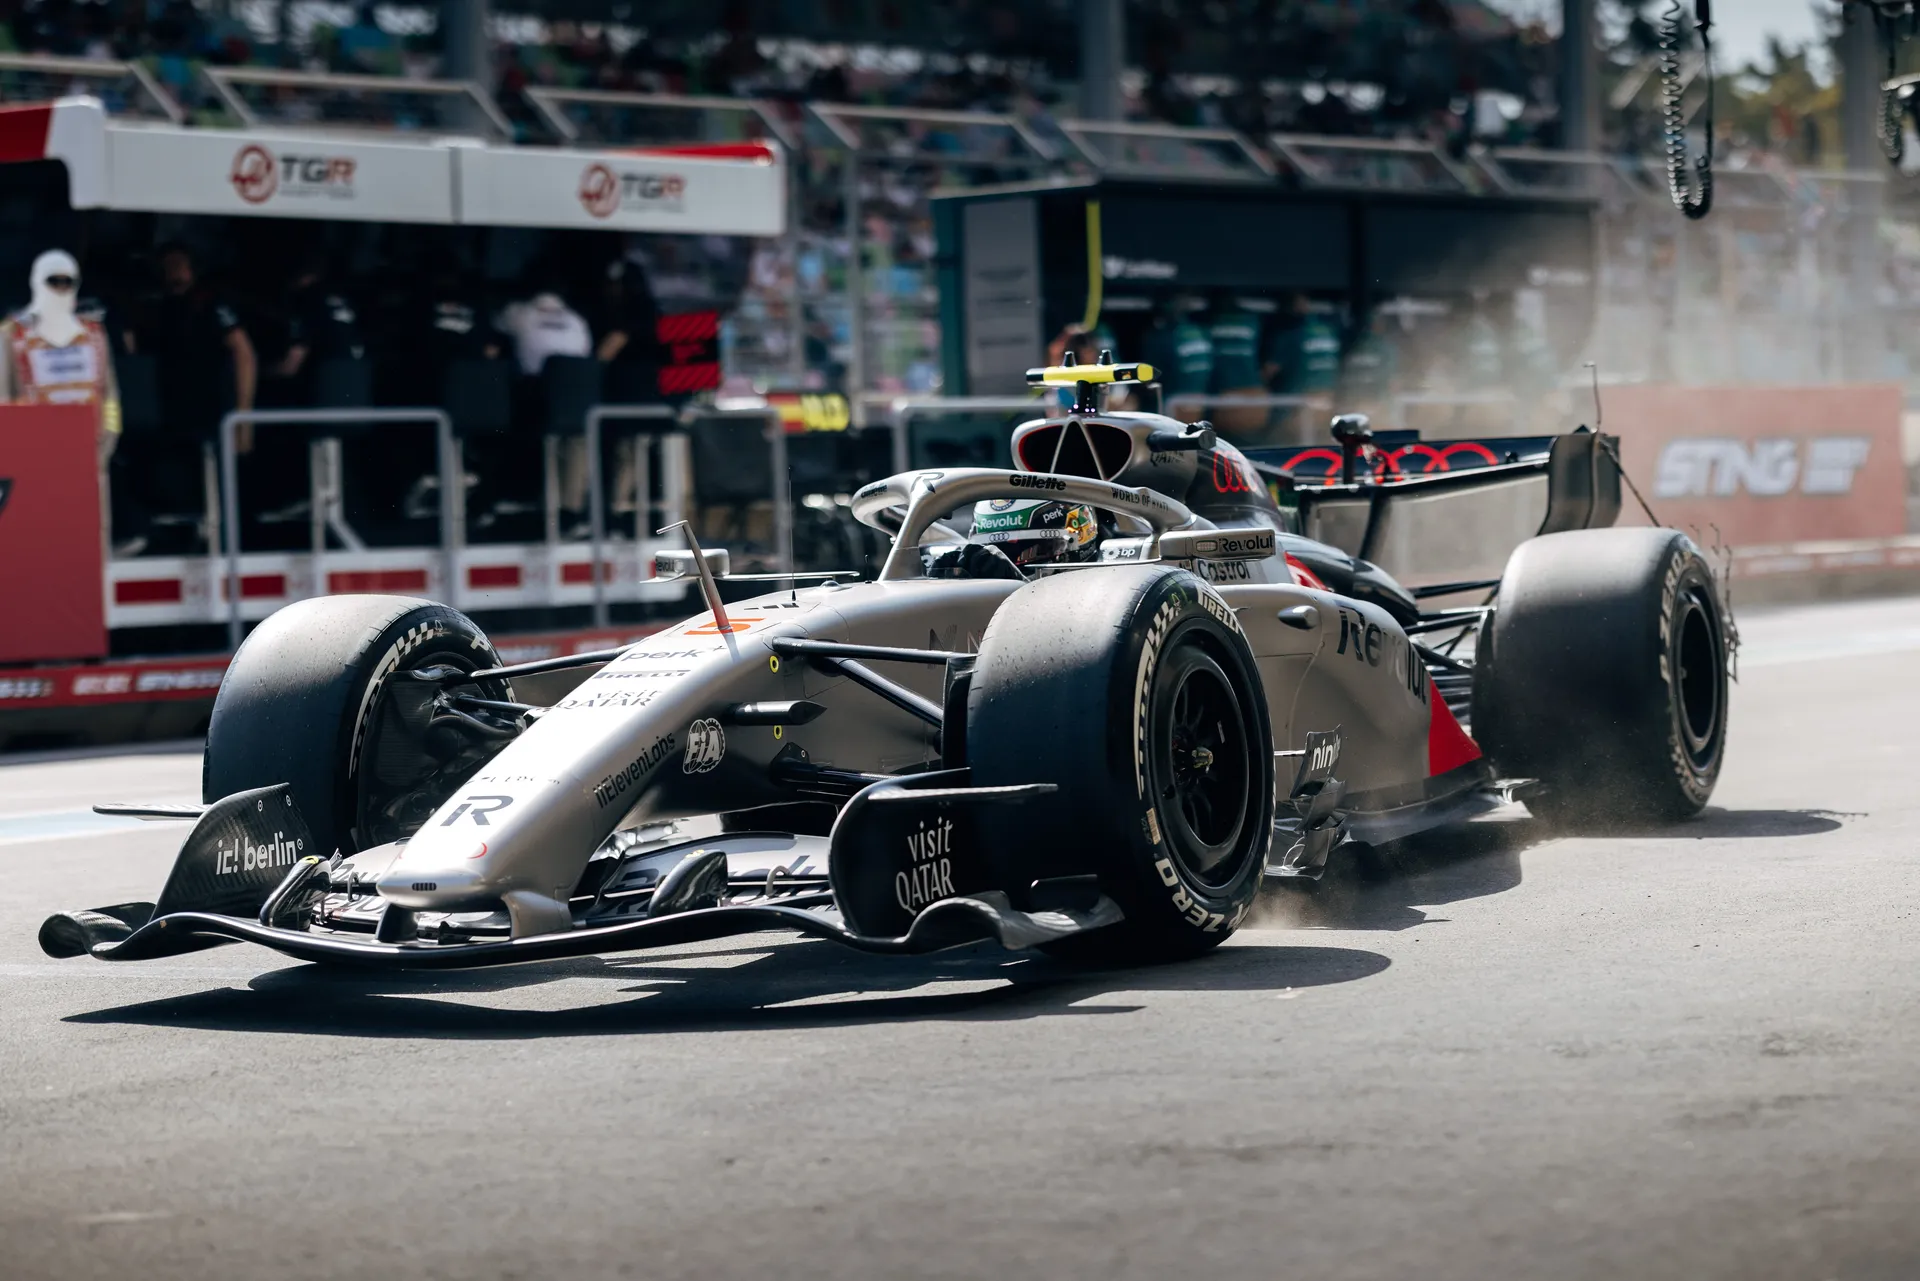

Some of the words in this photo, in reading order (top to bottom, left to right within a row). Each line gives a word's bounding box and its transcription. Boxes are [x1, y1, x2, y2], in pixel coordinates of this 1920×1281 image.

[1009, 474, 1067, 491] Gillette
[1111, 487, 1140, 504] WORLD
[1141, 494, 1151, 508] OF
[979, 514, 1023, 531] Revolut
[1042, 508, 1064, 524] perk
[1121, 548, 1136, 558] bp
[1198, 559, 1252, 582] Castrol
[620, 649, 704, 662] perk
[555, 698, 651, 710] QATAR
[907, 816, 954, 862] visit
[243, 830, 297, 871] berlin
[895, 858, 956, 916] QATAR
